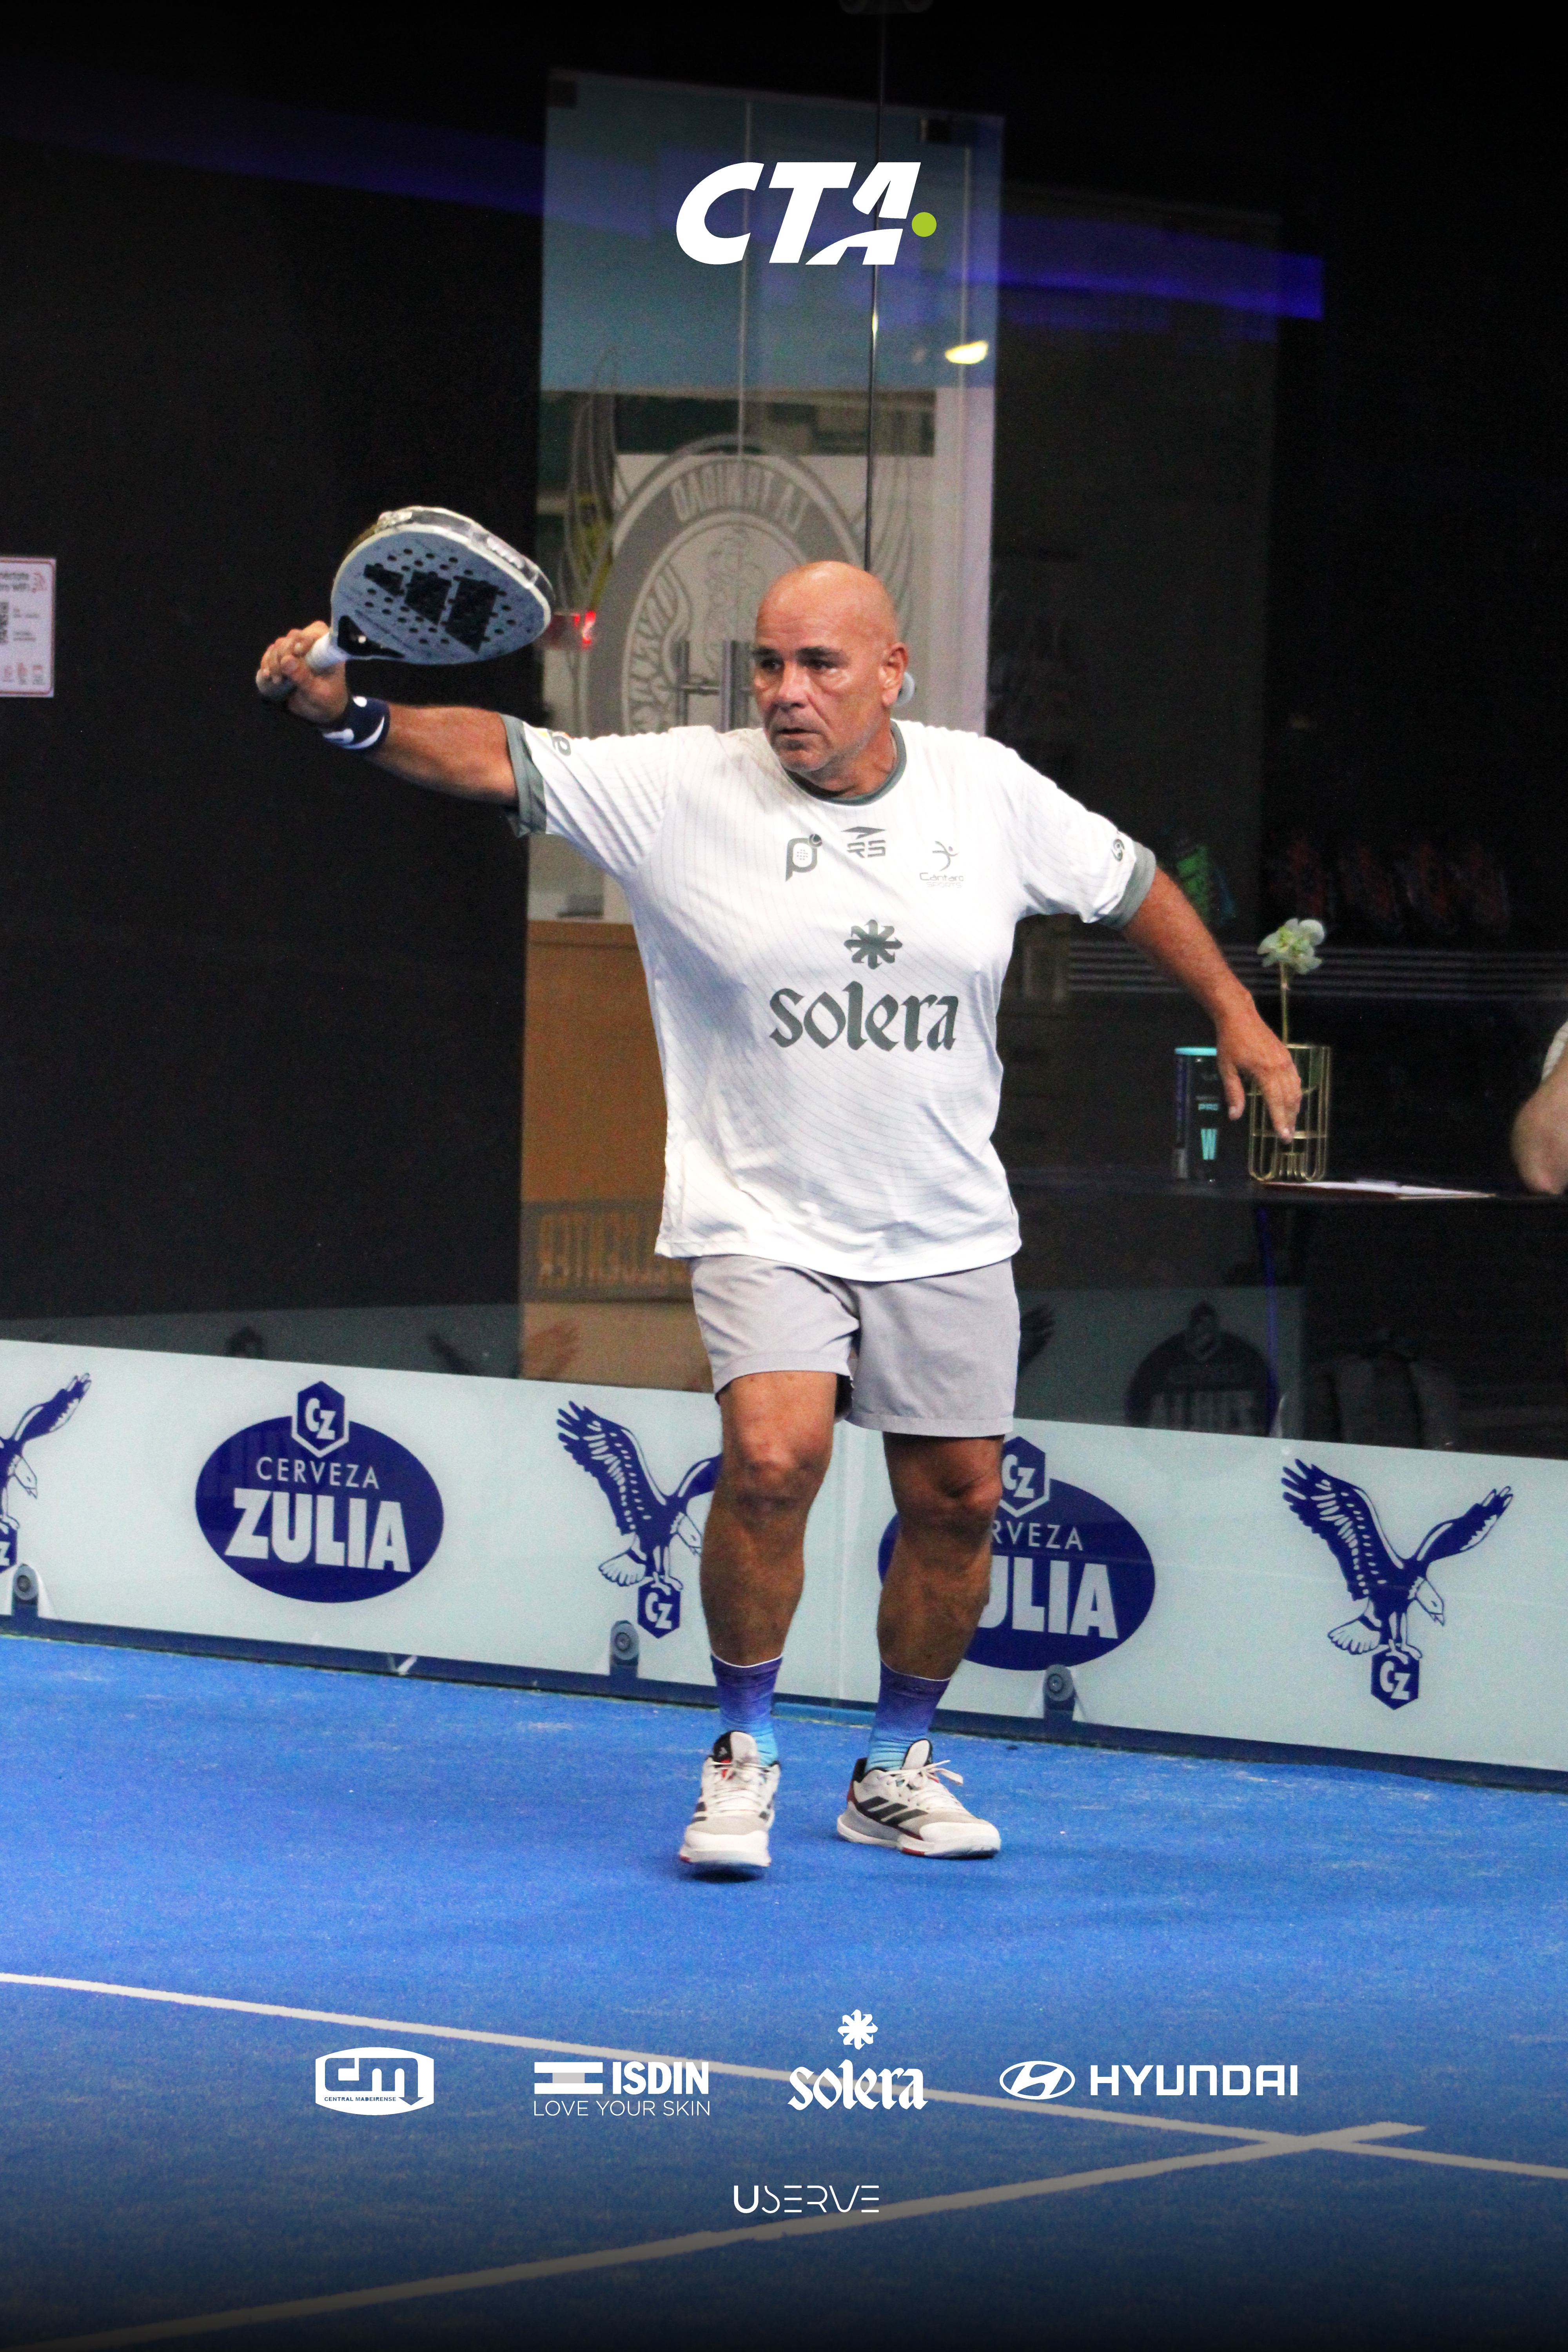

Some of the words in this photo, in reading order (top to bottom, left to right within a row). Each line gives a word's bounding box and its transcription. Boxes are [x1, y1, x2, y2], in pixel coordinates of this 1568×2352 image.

[769, 981, 959, 1051] solera
[305, 1397, 336, 1440] CZ
[256, 1456, 379, 1490] CERVEZA
[225, 1487, 411, 1573] ZULIA
[991, 1519, 1083, 1551] RVEZA
[645, 1592, 673, 1630] CZ
[978, 1554, 1118, 1639] ULIA
[1379, 1661, 1411, 1700] CZ
